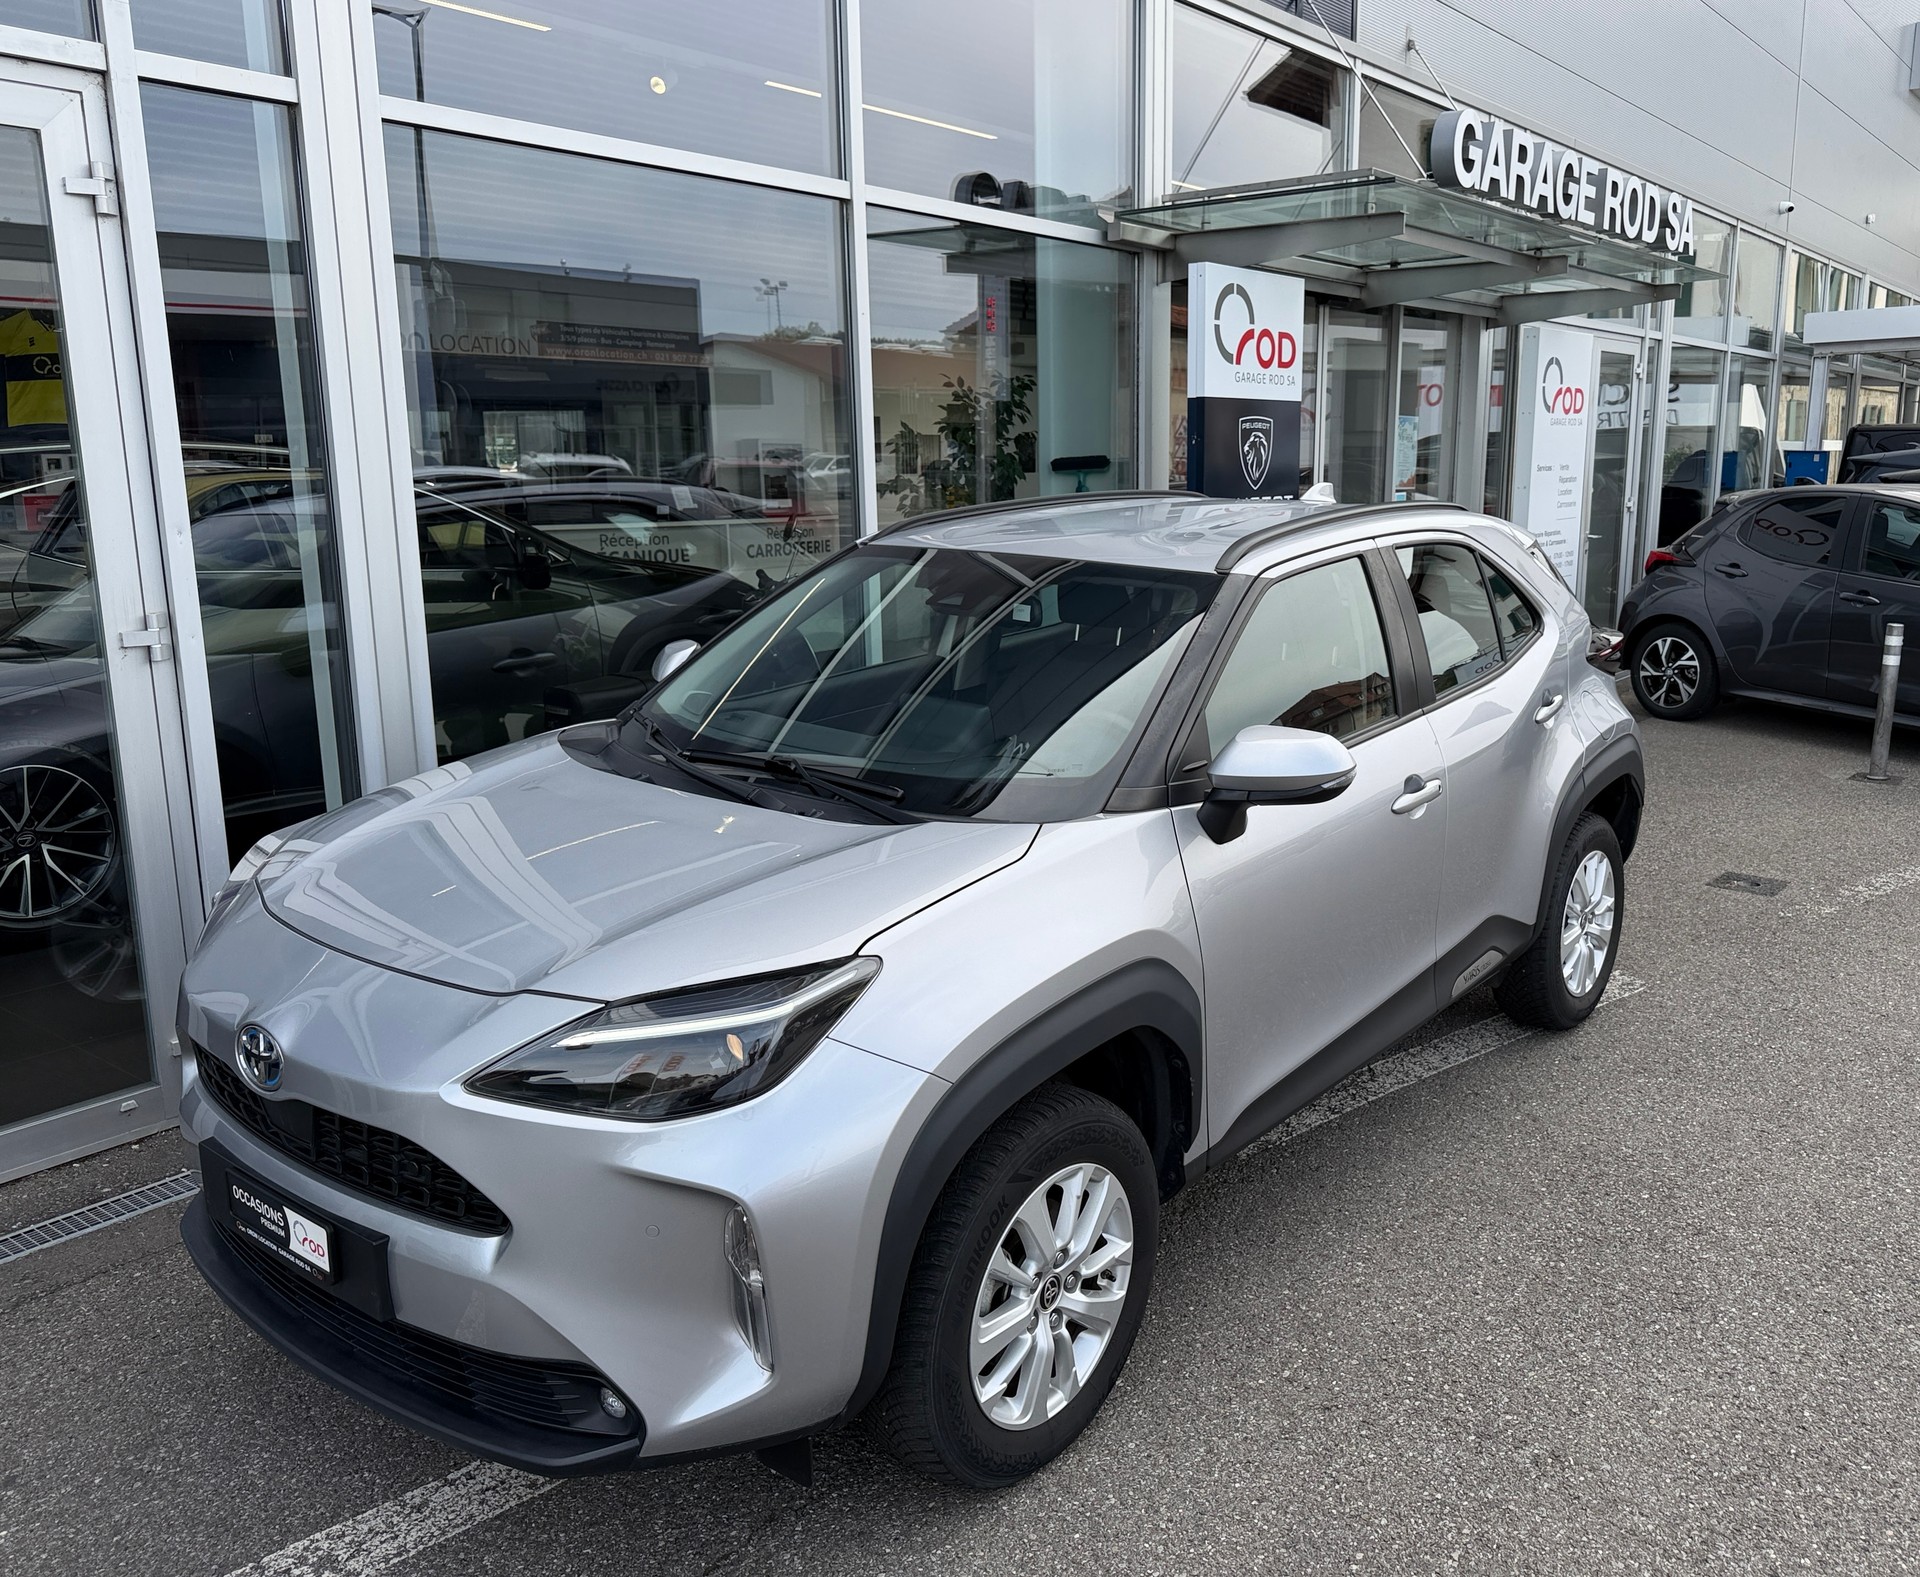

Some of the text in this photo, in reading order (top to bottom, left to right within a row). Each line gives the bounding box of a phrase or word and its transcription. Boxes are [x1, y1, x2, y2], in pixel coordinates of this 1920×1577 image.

[1453, 108, 1694, 257] GARAGE ROD SA
[560, 324, 575, 332] Tous
[575, 325, 591, 335] types
[593, 326, 600, 334] de
[631, 329, 656, 338] Tourisme
[430, 332, 531, 356] LOCATION
[577, 335, 598, 345] places
[600, 337, 612, 345] Bus
[616, 338, 643, 348] Camping
[646, 340, 675, 349] Remorque
[545, 347, 648, 361] www.oronlocation.ch
[655, 353, 670, 361] 021
[672, 354, 686, 363] 907
[1235, 371, 1296, 386] GARAGE ROD SA
[1241, 422, 1271, 430] PEUGEOT
[1550, 417, 1583, 426] GARAGE ROD SA
[600, 532, 670, 549] Récepion
[766, 526, 814, 541] Récon
[746, 539, 831, 559] CARROSSERIE
[232, 1185, 285, 1227] OCCASIONS
[260, 1216, 286, 1239] PREMIUM
